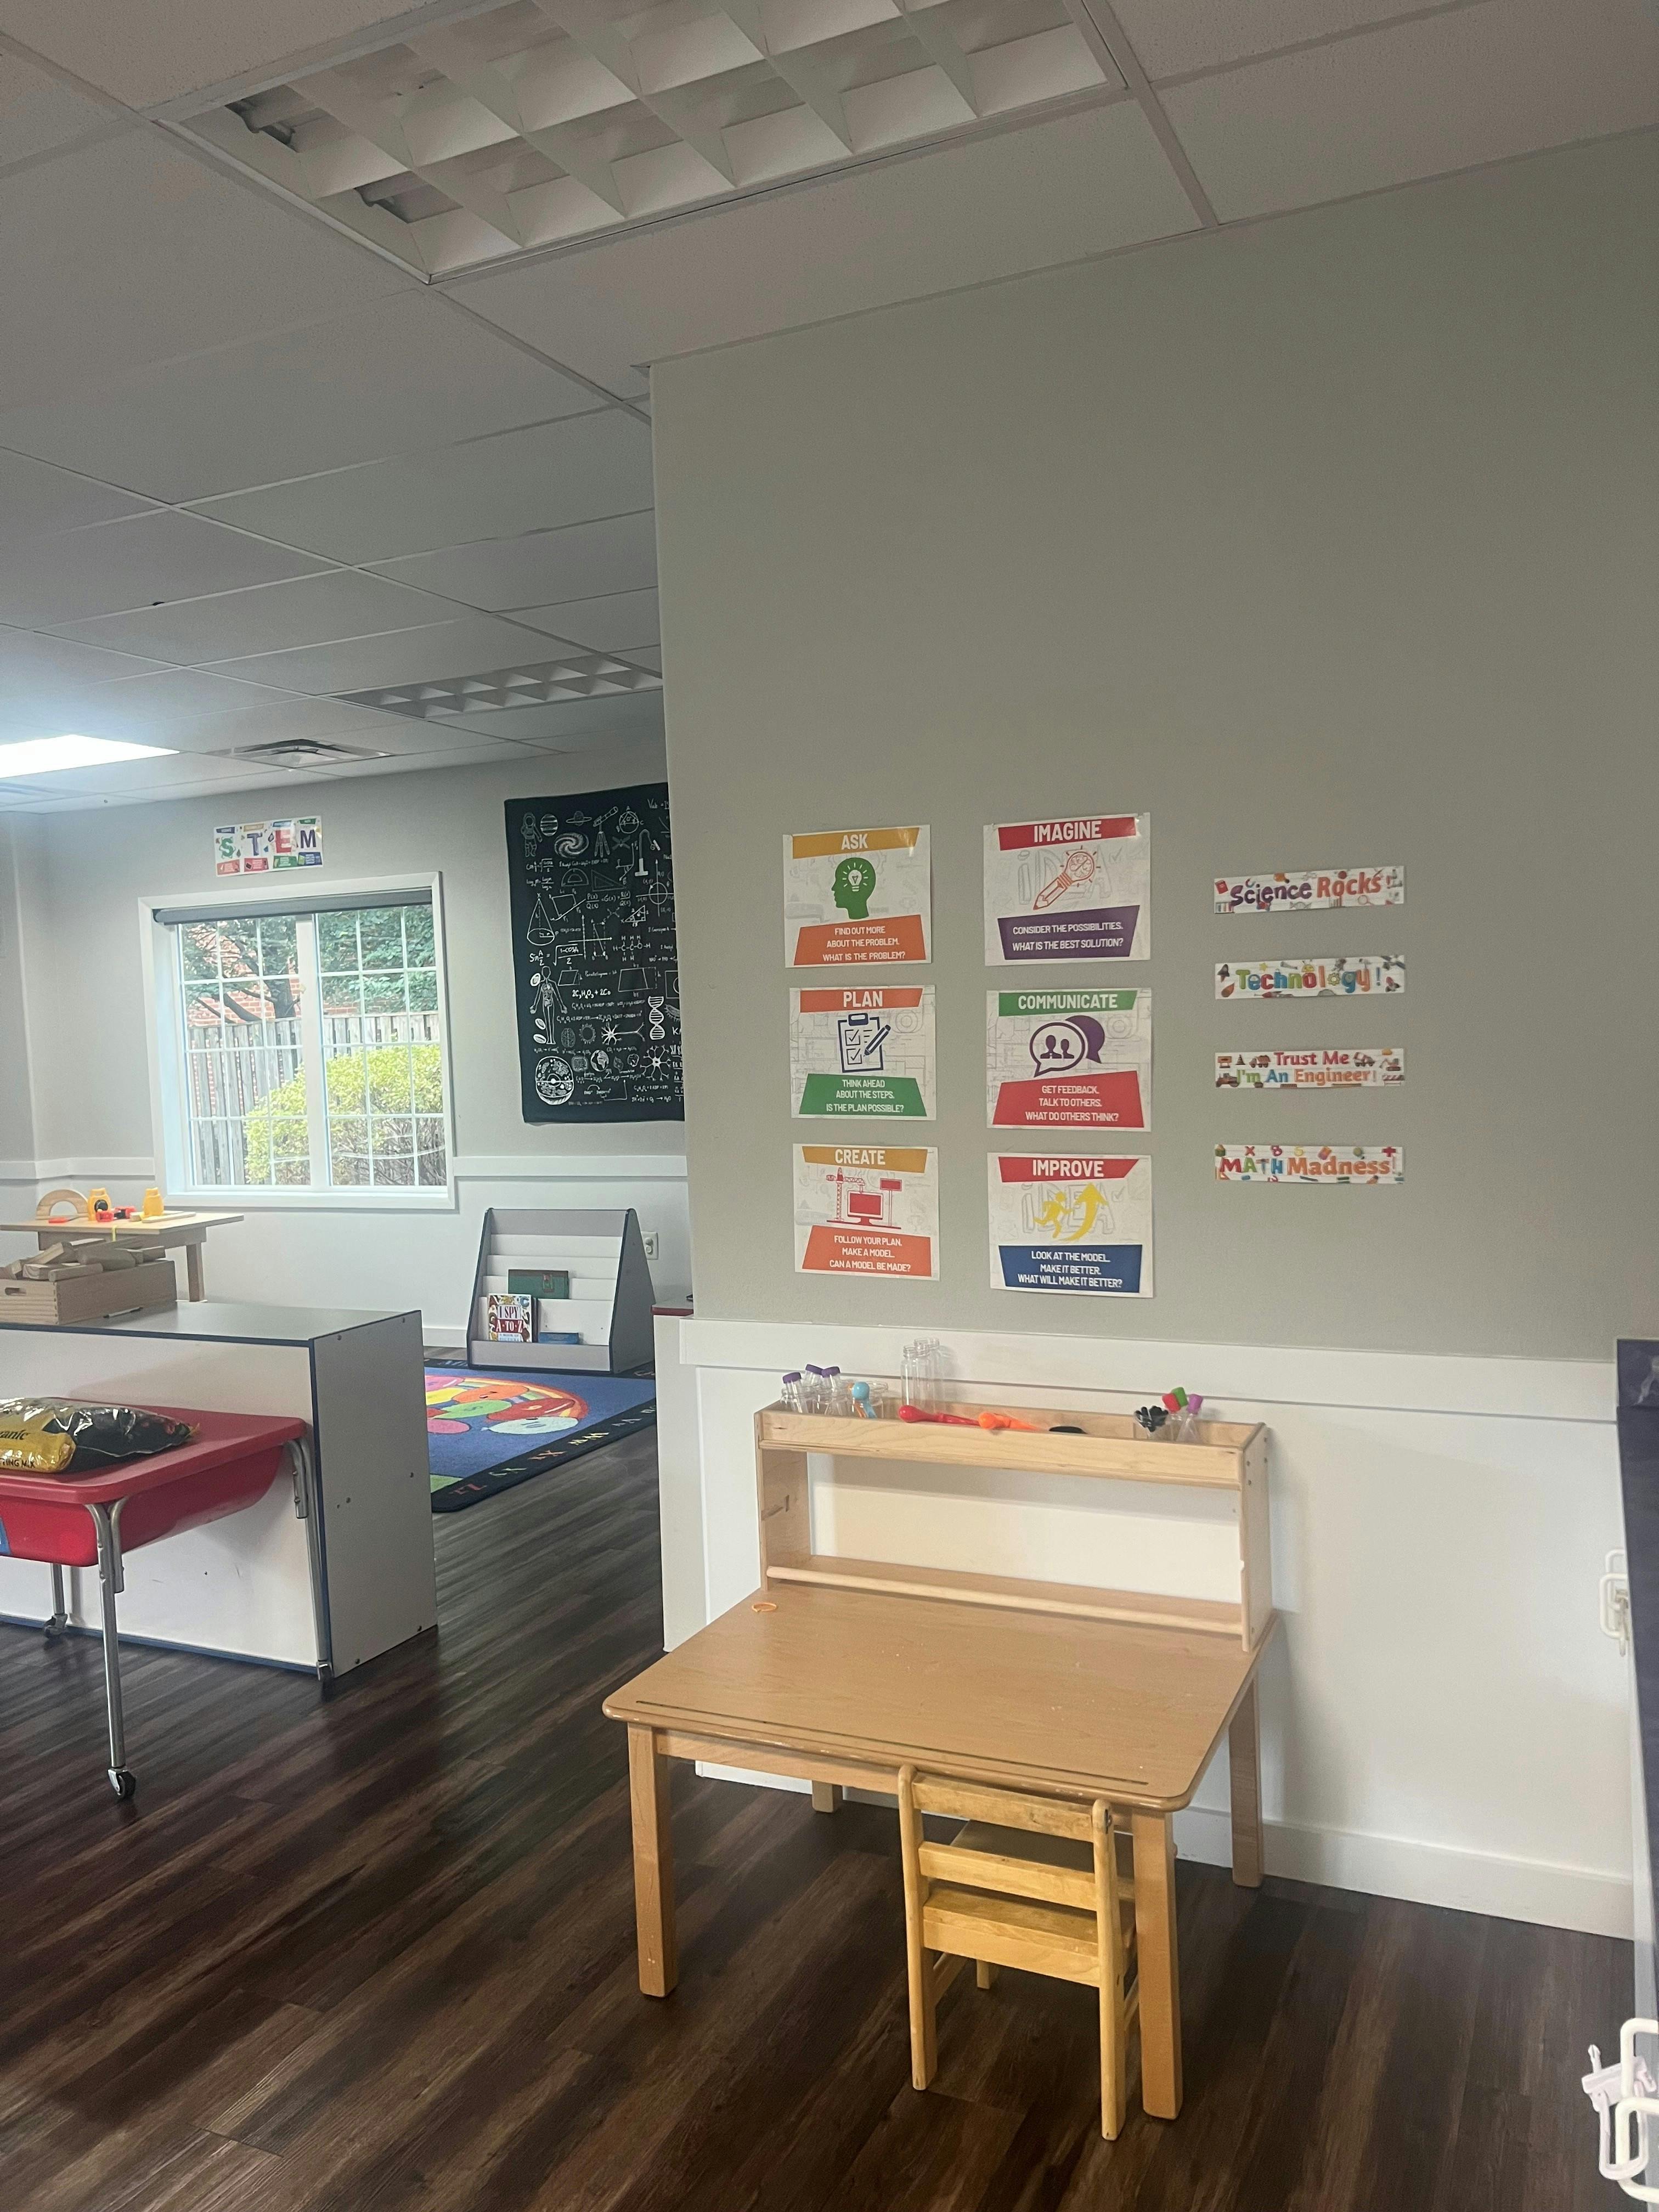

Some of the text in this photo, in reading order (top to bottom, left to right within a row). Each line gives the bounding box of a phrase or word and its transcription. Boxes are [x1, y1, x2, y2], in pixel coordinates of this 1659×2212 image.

[1034, 821, 1102, 843] IMAGINE
[219, 829, 317, 859] STEM
[842, 833, 868, 850] ASK
[1229, 882, 1312, 907] Science
[1013, 922, 1123, 935] CONSIDER THE POSSIBILITIES.
[827, 938, 899, 947] ABOUT THE PROBLEM.
[1012, 938, 1124, 951] WHAT IS THE BEST SOLUTION?
[869, 951, 905, 960] PROBLEM?
[843, 991, 883, 1008] PLAN
[1018, 994, 1118, 1011] COMMUNICATE
[1273, 1051, 1349, 1066] Trust Me
[1237, 1069, 1260, 1083] I'm
[1265, 1069, 1288, 1082] An
[842, 1079, 885, 1088] THINK AHEAD
[836, 1090, 857, 1098] ABOUT
[873, 1091, 895, 1099] STEPS.
[1057, 1086, 1099, 1094] FEEDBACK.
[848, 1104, 867, 1112] PLAN
[868, 1104, 904, 1113] POSSIBLE?
[1039, 1098, 1102, 1107] TALK TO OTHERS.
[1025, 1111, 1119, 1121] WHAT DO OTHERS THINK?
[835, 1148, 885, 1165] CREATE
[1032, 1159, 1104, 1178] IMPROVE
[1220, 1156, 1283, 1174] MATH
[834, 1235, 902, 1246] FOLLOW YOUR PLAN.
[842, 1248, 862, 1256] MAKE
[870, 1249, 895, 1258] MODEL.
[1031, 1251, 1111, 1262] LOOK AT THE MODEL.
[830, 1260, 845, 1268] CAN
[845, 1260, 851, 1268] A
[852, 1261, 876, 1269] MODEL
[887, 1263, 911, 1272] MADE?
[1040, 1264, 1102, 1275] MAKE IT BETTER.
[1018, 1274, 1123, 1288] WHAT WILL MAKE IT BETTER?
[499, 1306, 518, 1318] I SPY
